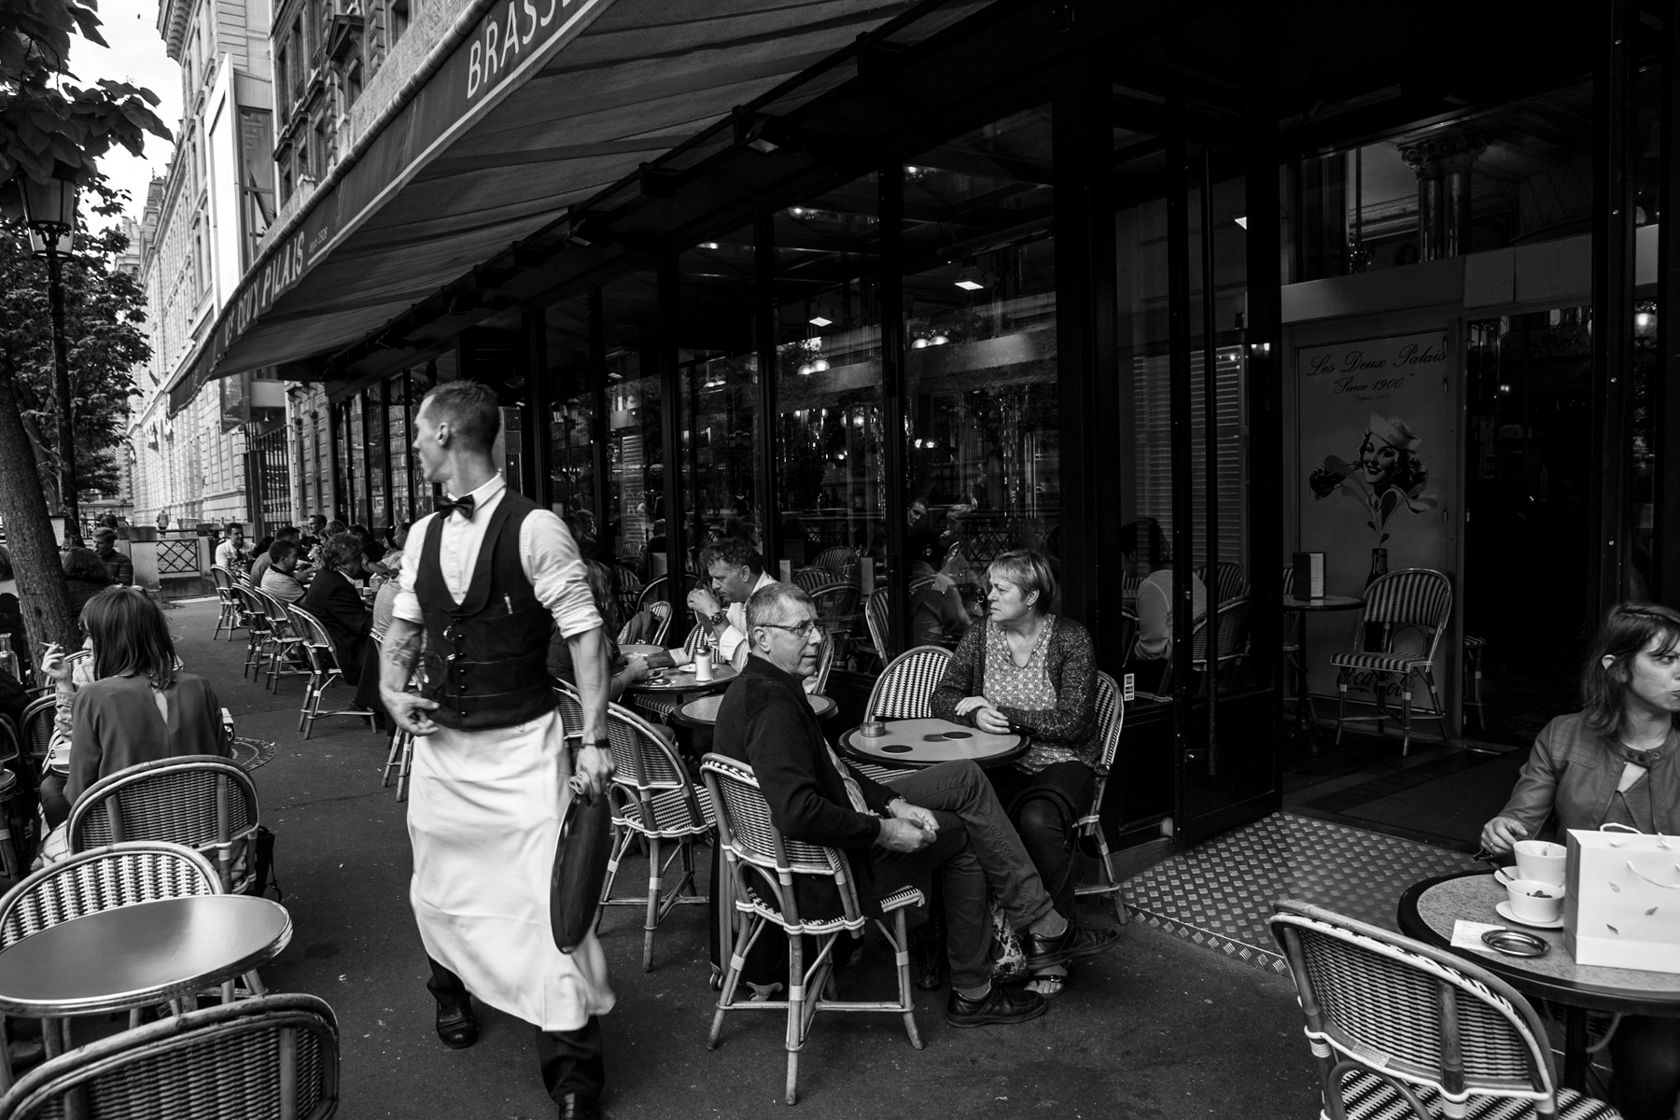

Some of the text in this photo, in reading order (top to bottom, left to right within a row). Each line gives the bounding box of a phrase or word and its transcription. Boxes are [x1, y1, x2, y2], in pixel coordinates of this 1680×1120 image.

[467, 0, 572, 99] BRAS
[1306, 344, 1447, 376] Les Deux Palais
